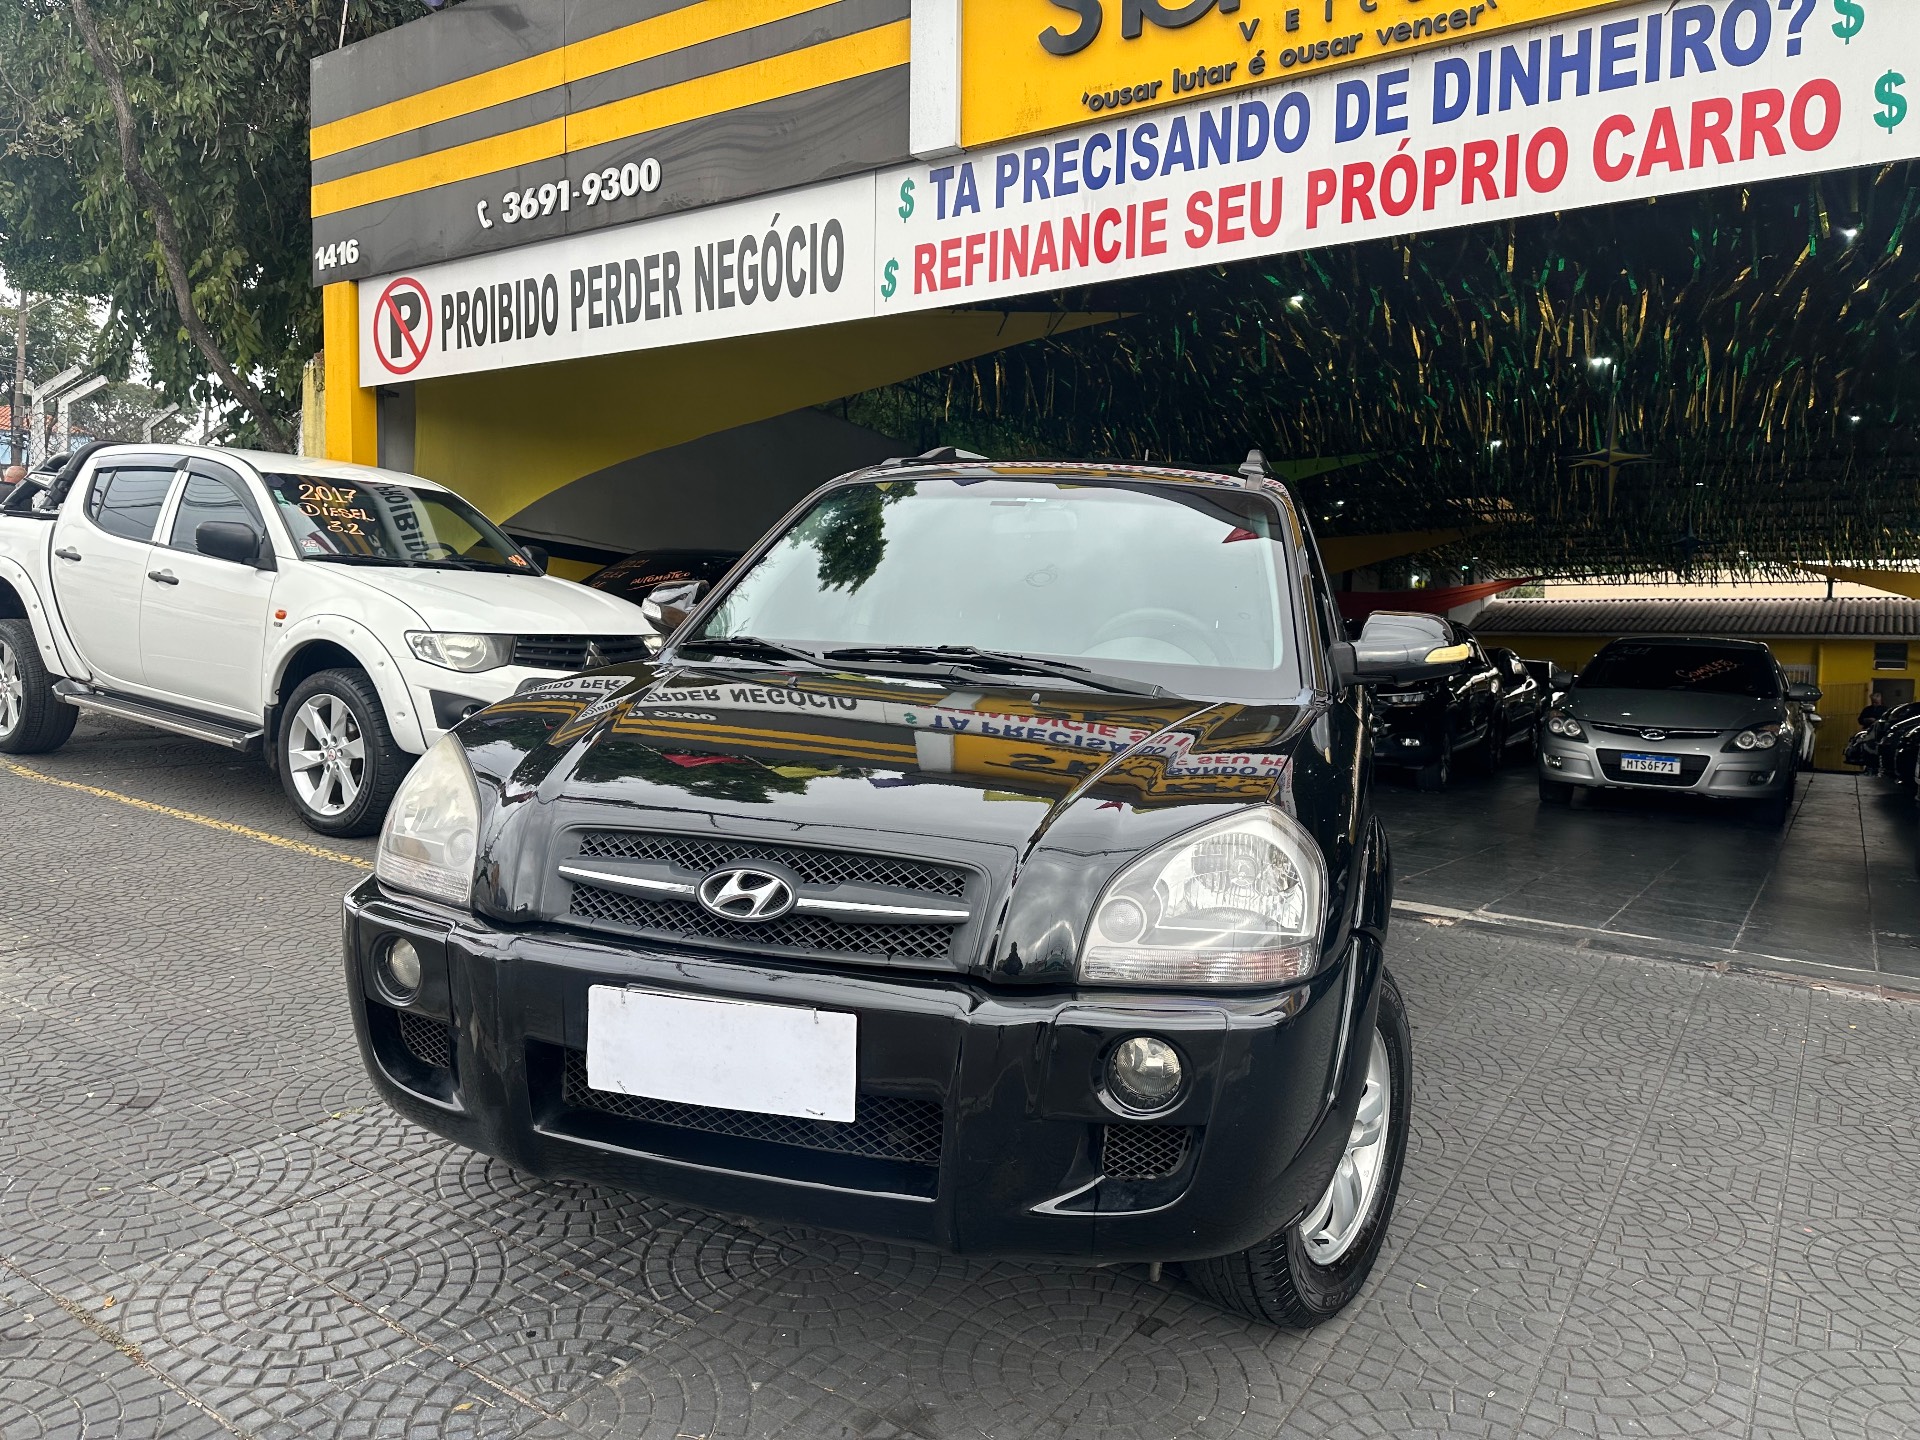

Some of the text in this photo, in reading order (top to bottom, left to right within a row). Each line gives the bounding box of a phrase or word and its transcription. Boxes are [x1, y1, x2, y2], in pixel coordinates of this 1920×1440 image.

[1173, 62, 1237, 94] lutar
[1249, 50, 1265, 76] é
[1280, 33, 1366, 68] ousar
[929, 163, 980, 220] TA
[996, 92, 1310, 208] PRECISANDO
[1335, 68, 1410, 144] DE
[502, 158, 662, 224] 3691-9300
[914, 198, 1168, 294] REFINANCIE
[1184, 176, 1283, 249] SEU
[1306, 138, 1569, 229] PRÓPRIO
[1593, 78, 1842, 182] CARRO
[314, 238, 359, 271] 1416
[441, 212, 845, 352] PROIBIDO PERDER NEGÓCIO
[299, 484, 356, 503] 2017
[327, 521, 366, 536] 3.2
